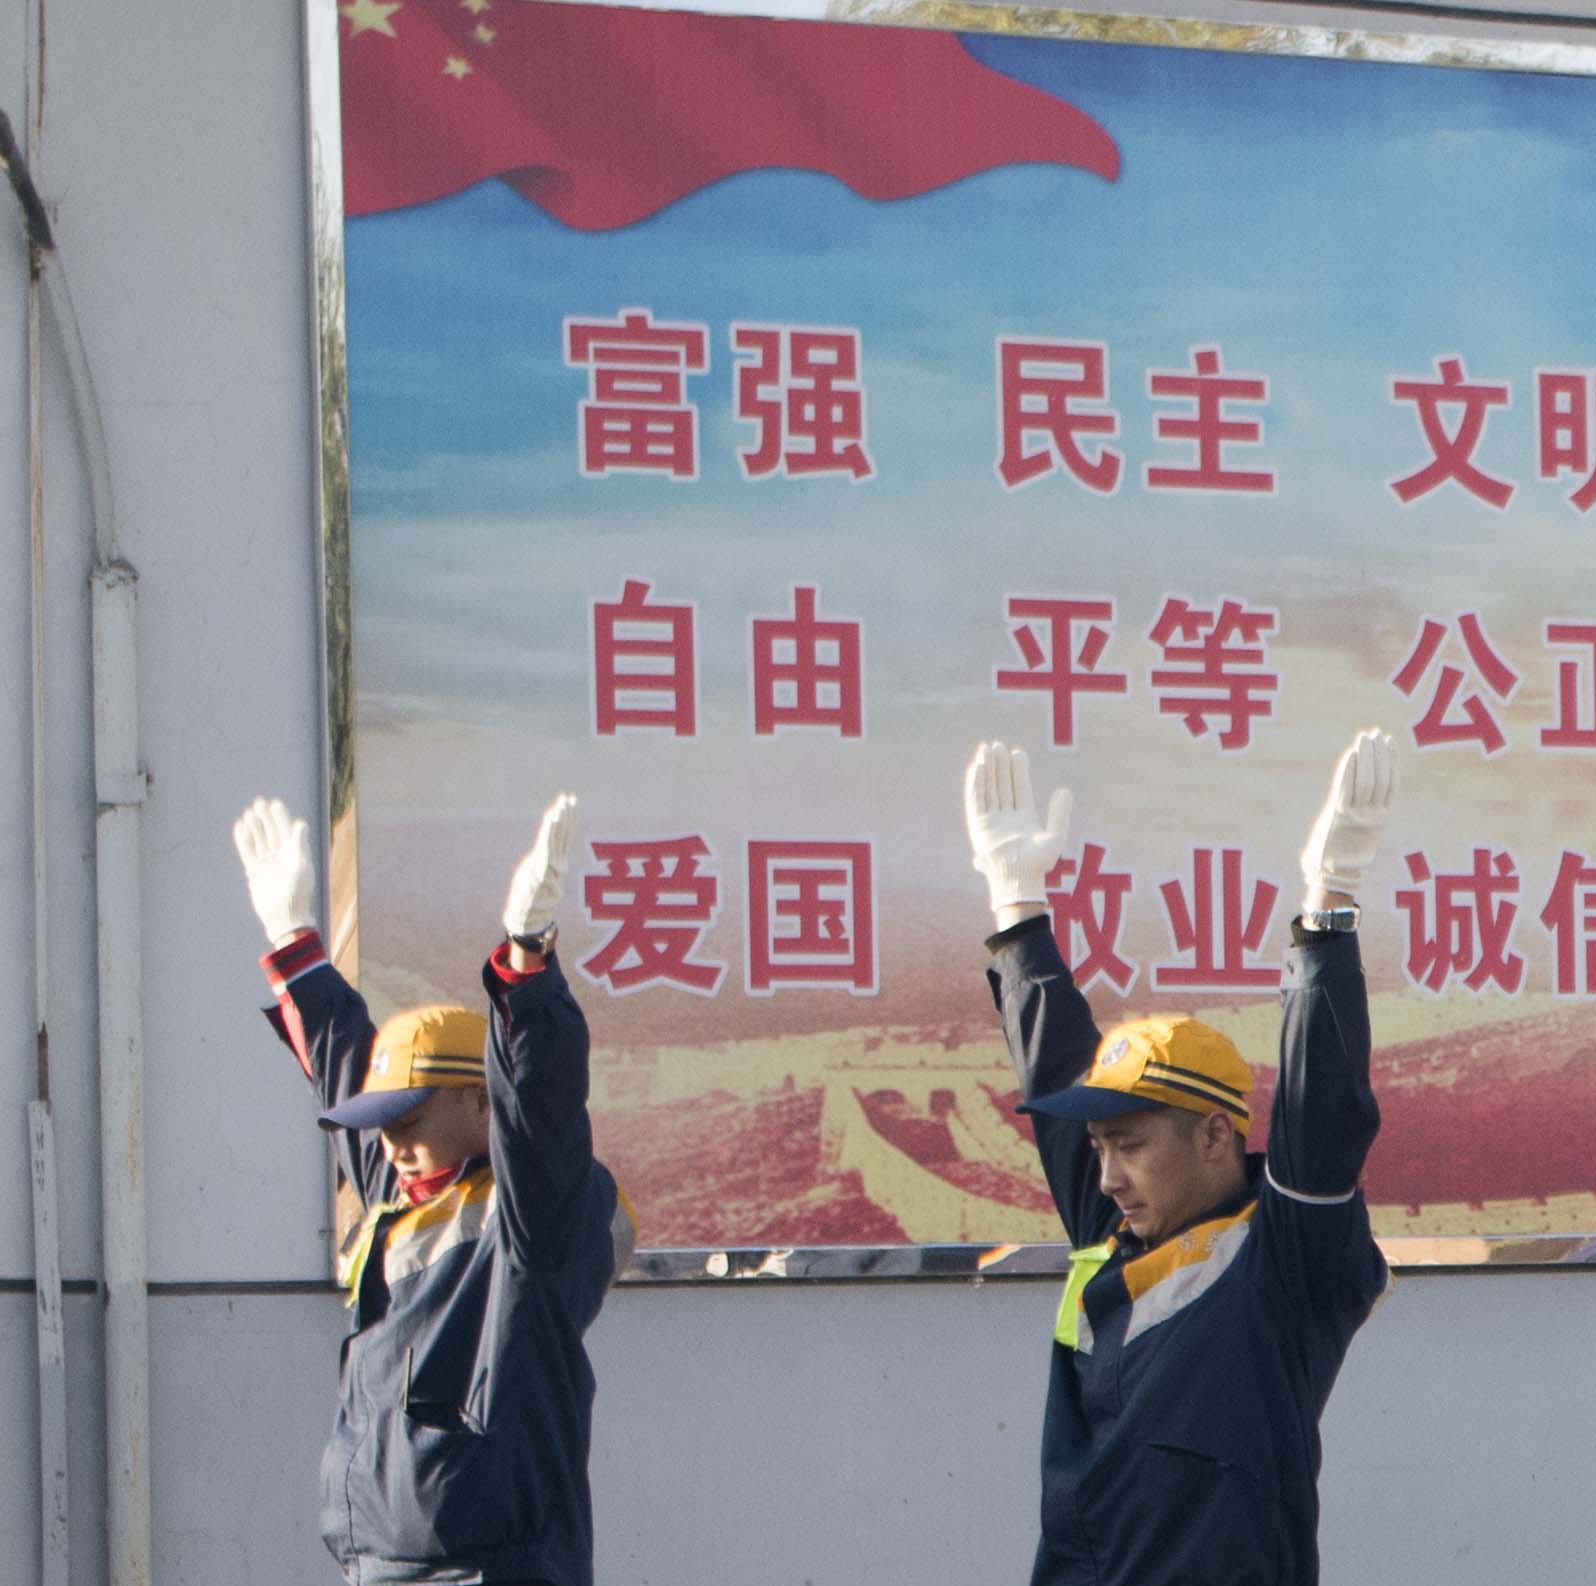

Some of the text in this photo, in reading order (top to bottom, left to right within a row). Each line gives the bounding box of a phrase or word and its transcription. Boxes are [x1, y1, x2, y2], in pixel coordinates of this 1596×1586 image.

[570, 315, 869, 475] 富强
[998, 341, 1276, 492] 民主
[593, 580, 863, 738] 自由
[996, 598, 1278, 750] 平等
[582, 836, 874, 991] 爱国
